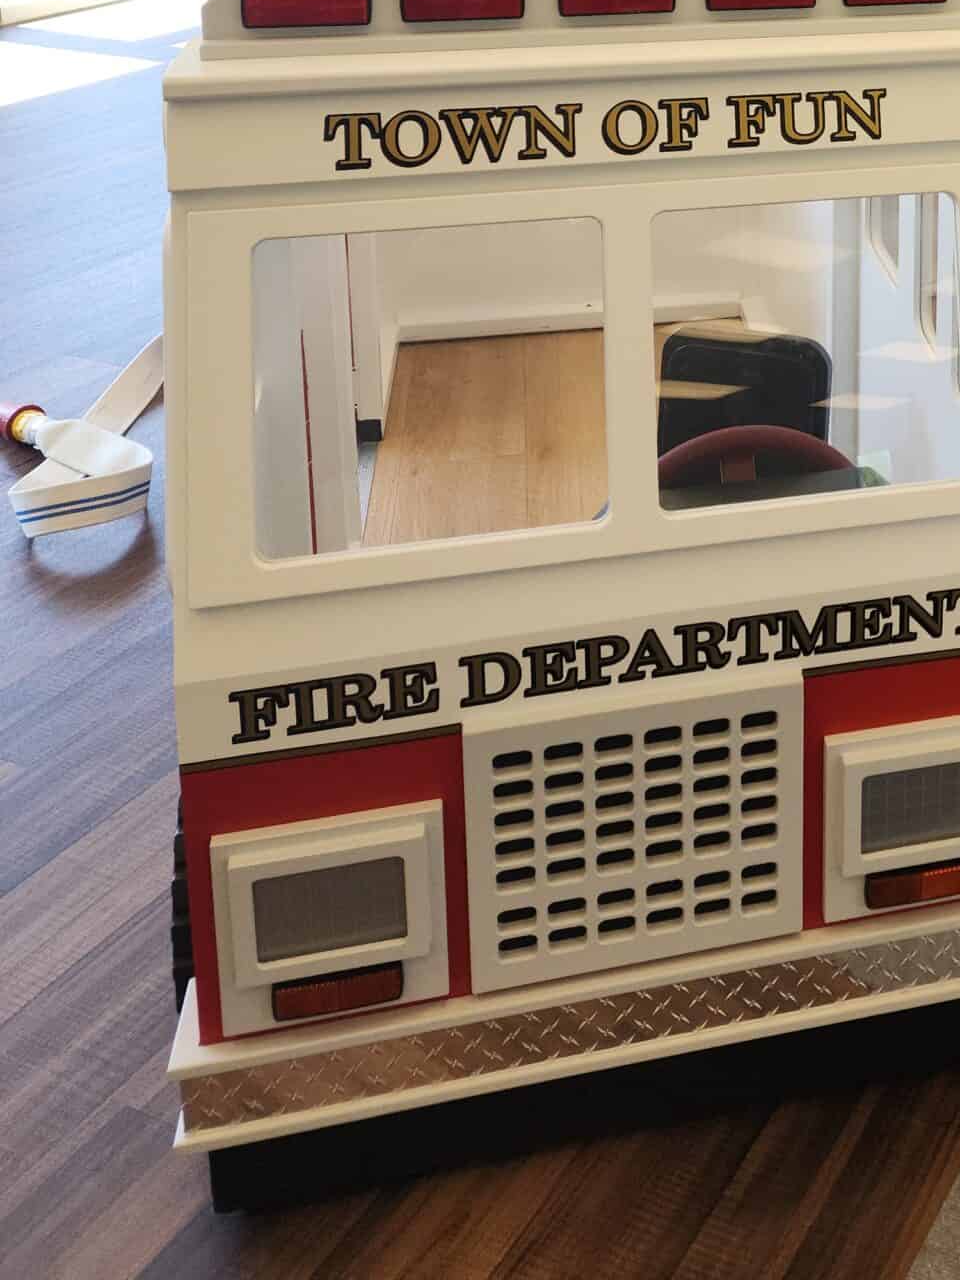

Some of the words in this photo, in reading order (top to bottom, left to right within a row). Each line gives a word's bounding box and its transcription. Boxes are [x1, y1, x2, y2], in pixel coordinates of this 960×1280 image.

[323, 103, 583, 171] TOWN
[601, 97, 710, 155] OF
[726, 88, 888, 148] FUN
[229, 661, 441, 744] FIRE
